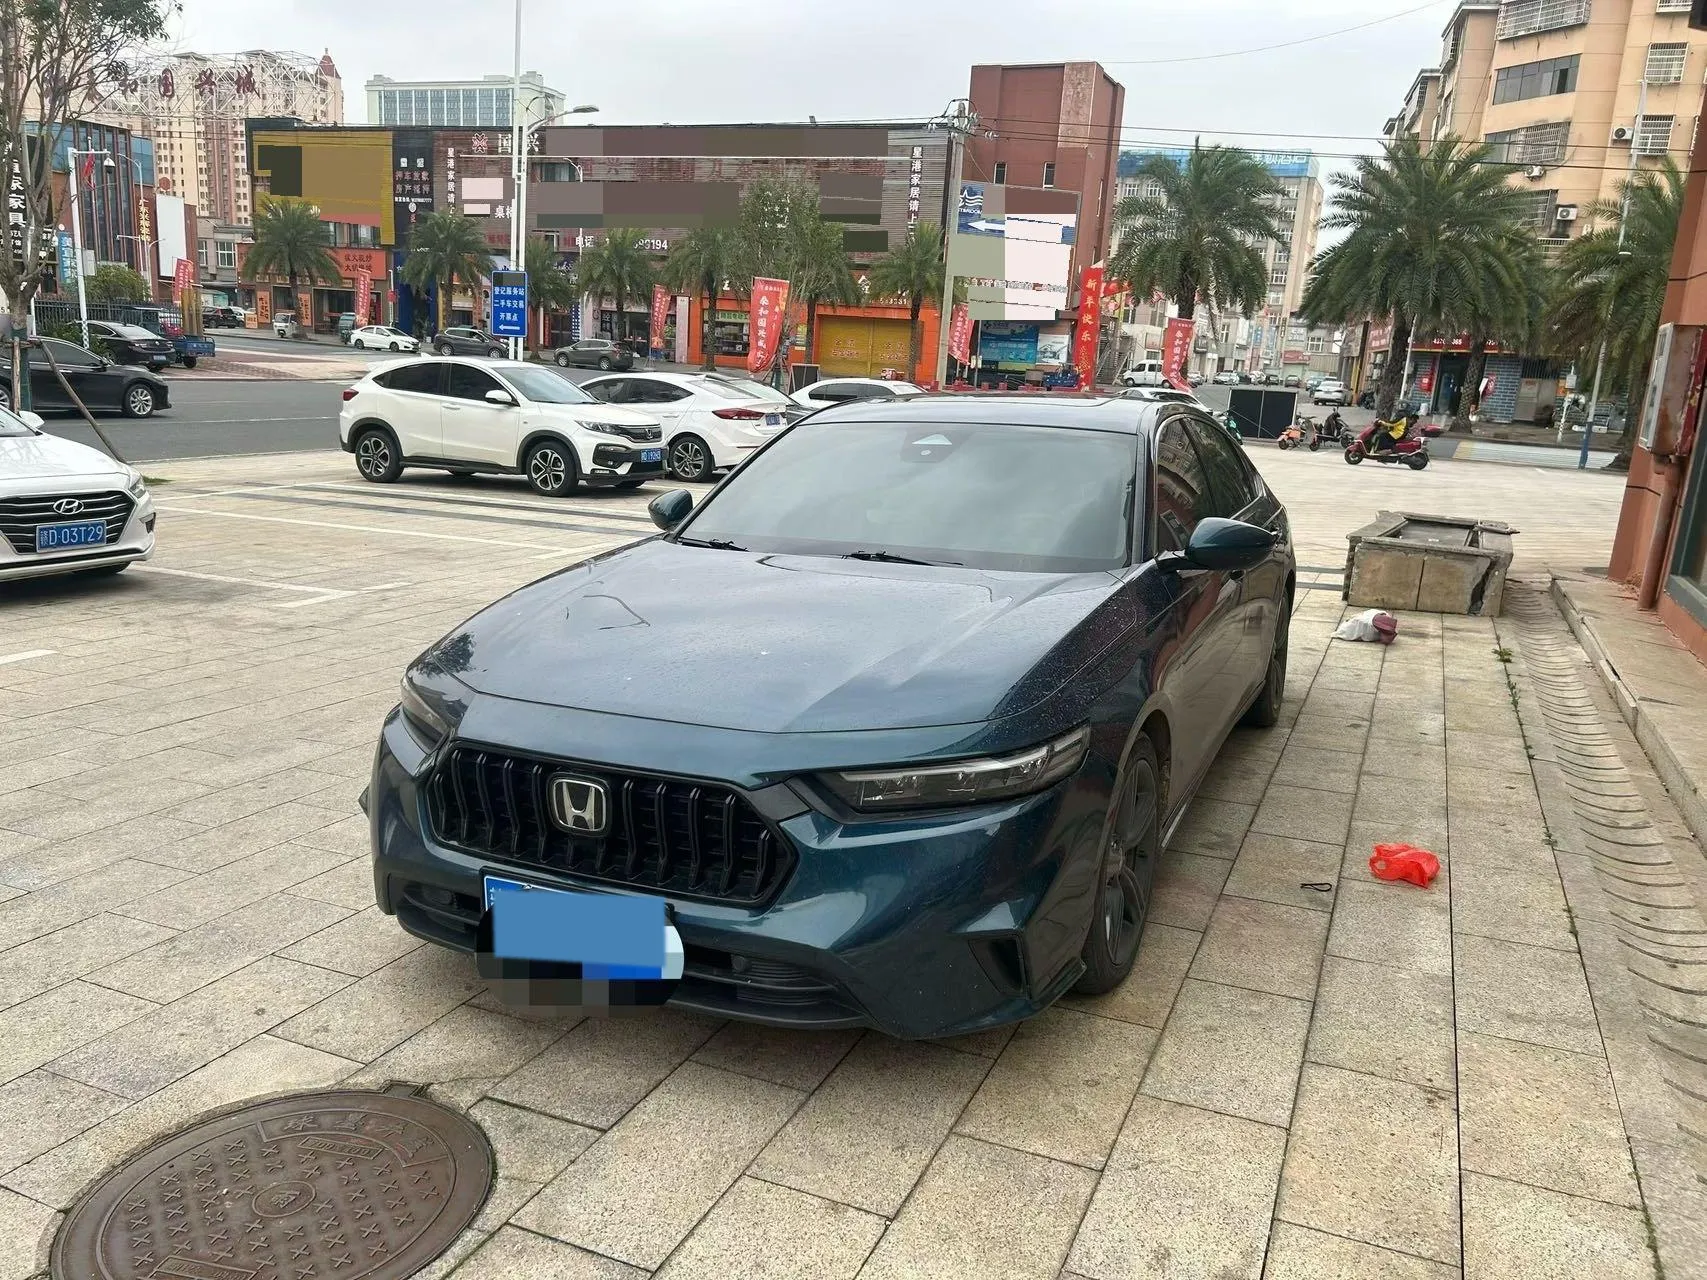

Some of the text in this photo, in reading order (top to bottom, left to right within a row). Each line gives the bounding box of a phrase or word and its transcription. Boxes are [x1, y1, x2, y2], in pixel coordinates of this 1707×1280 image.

[493, 299, 525, 309] 二手车交易
[1081, 279, 1098, 342] 新年快乐
[499, 312, 519, 322] 开票点
